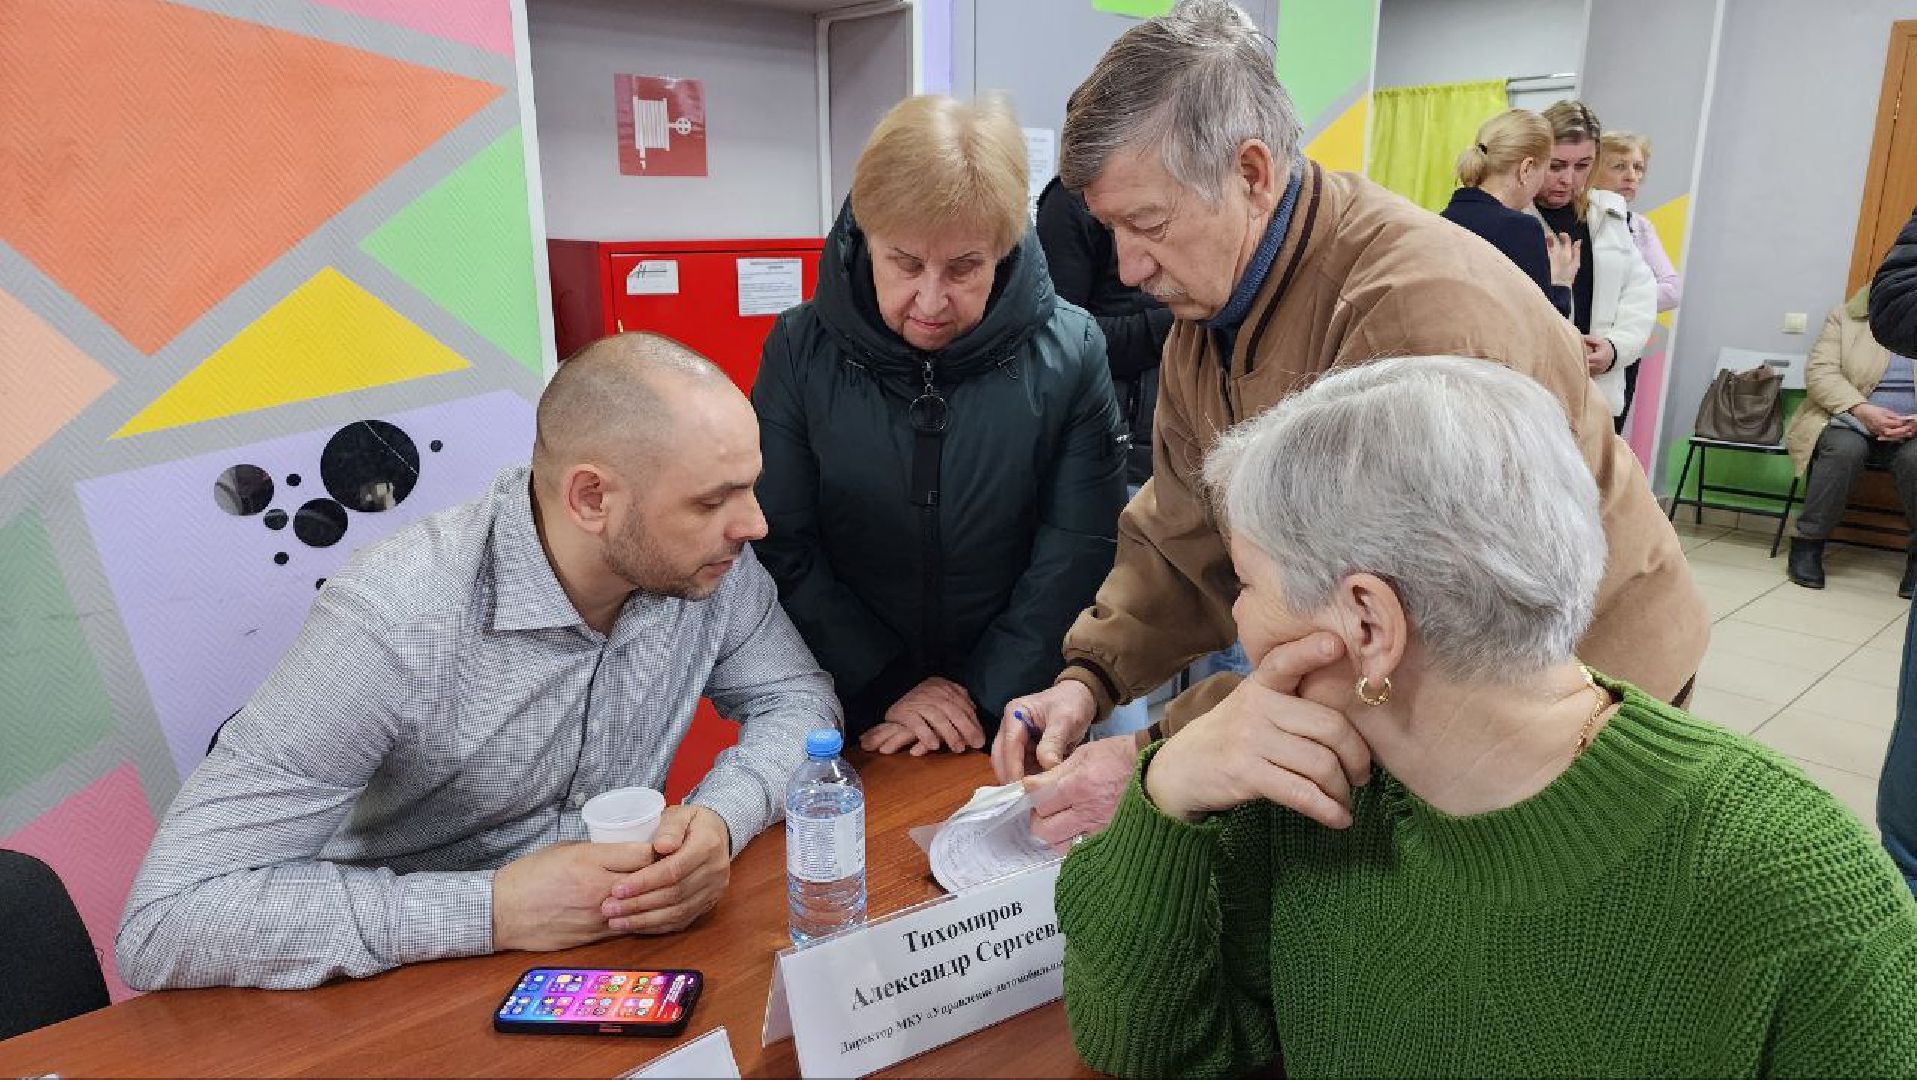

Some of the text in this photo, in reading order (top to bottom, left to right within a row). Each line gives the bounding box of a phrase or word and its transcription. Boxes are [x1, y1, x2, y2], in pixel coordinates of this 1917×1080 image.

[903, 901, 1022, 953] Тихомиров
[852, 923, 1062, 1010] Александр Сергеев
[840, 1026, 893, 1054] Директор
[896, 1011, 924, 1032] МКУ
